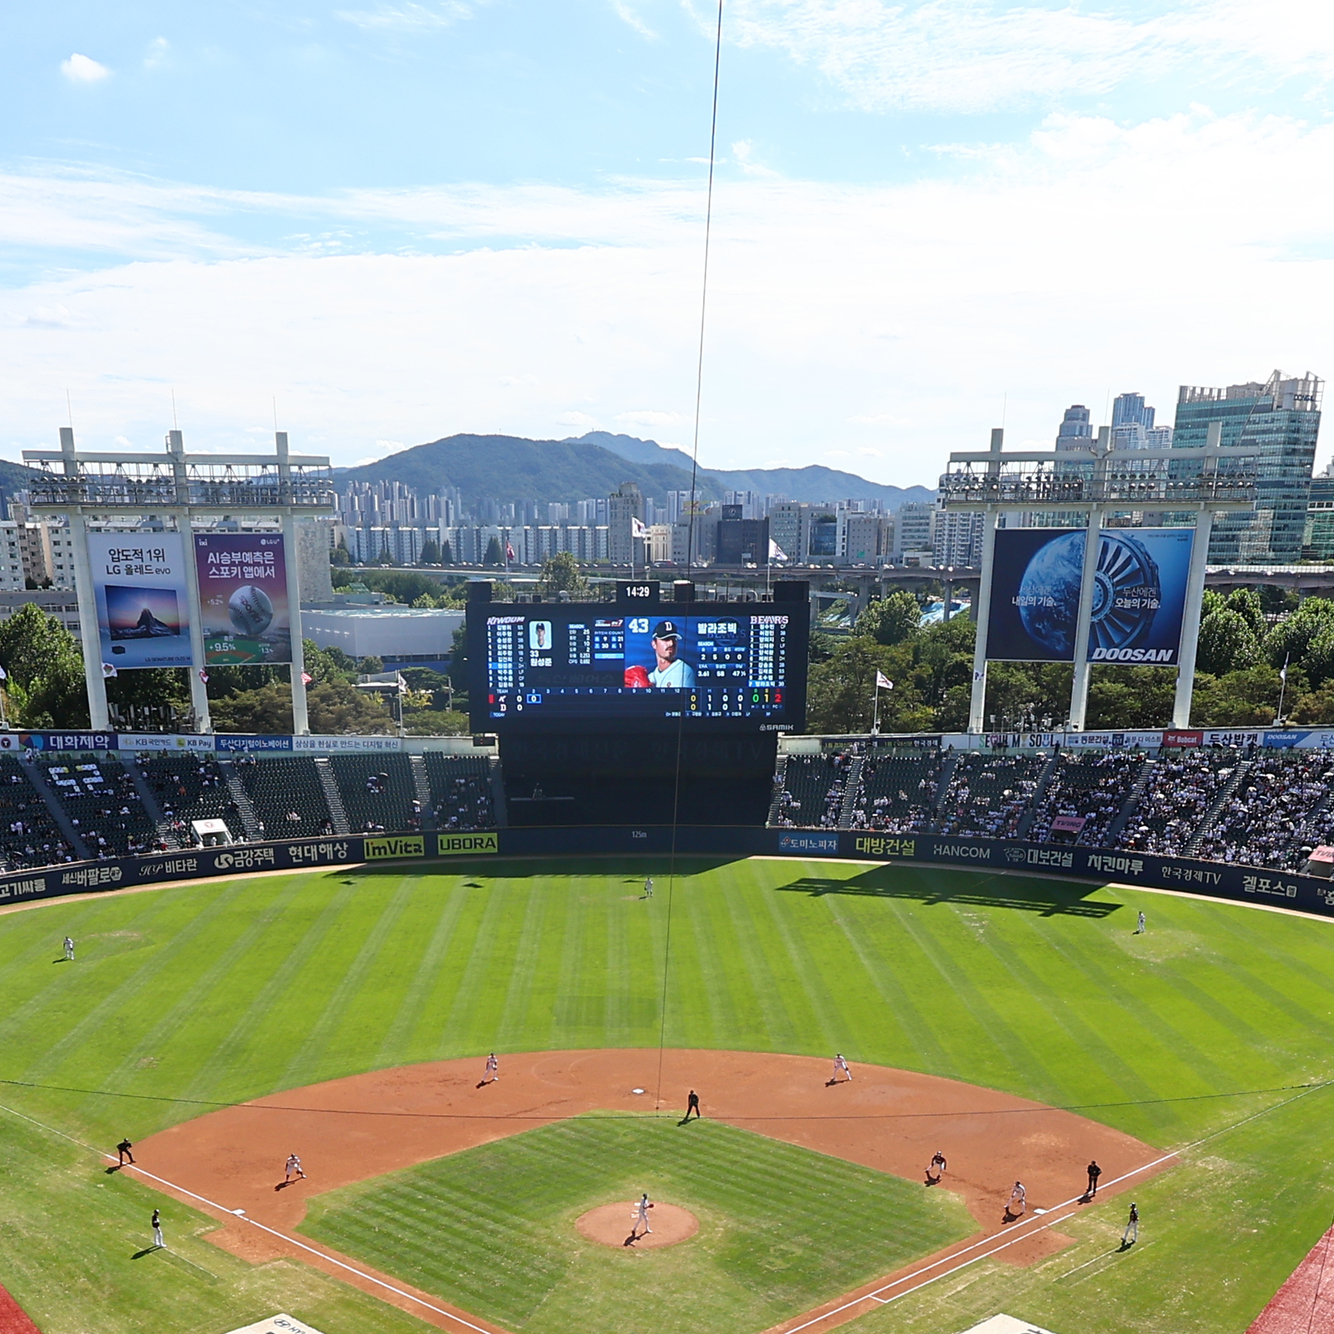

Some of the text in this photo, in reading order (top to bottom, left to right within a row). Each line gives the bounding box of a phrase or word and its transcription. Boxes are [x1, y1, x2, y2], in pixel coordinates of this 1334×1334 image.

[108, 548, 165, 563] 압도적 1위
[207, 551, 275, 565] AI승부예측은
[106, 564, 171, 575] LG 올레드 evo
[208, 566, 275, 579] 스포키 앱에서
[626, 586, 650, 597] 14:29
[1122, 587, 1157, 598] 두산에겐
[1012, 596, 1058, 607] 내일의 기술.
[1115, 598, 1161, 609] 오늘의 기술.
[628, 618, 649, 633] 43
[665, 622, 672, 631] D
[750, 616, 789, 625] BEARS
[697, 623, 737, 635] 발라조빅
[209, 642, 236, 652] +9.5%
[1092, 647, 1174, 662] DOOSAN
[753, 694, 759, 702] 0
[774, 694, 782, 702] 2
[49, 735, 110, 749] 대화제약
[187, 739, 212, 748] KB Pay
[220, 738, 289, 749] 두산디지털이노베이션
[295, 738, 316, 749] 상상을
[318, 738, 338, 749] 현실로
[340, 738, 361, 749] 만드는
[1176, 735, 1198, 743] Bobcat
[1209, 733, 1258, 747] 두산밥캣
[1056, 820, 1082, 828] TVING
[439, 836, 497, 852] UBORA
[790, 839, 837, 850] 도미노피자
[855, 837, 916, 857] 대방건설
[234, 848, 275, 868] 금강주택
[288, 842, 349, 863] 현대해상
[933, 844, 991, 859] HANCOM
[1027, 849, 1074, 868] 대보건설
[1087, 854, 1144, 876] 치킨마루
[165, 858, 198, 874] 비타란
[1162, 866, 1222, 885] 한국경제TV
[1242, 875, 1286, 896] 겔포스
